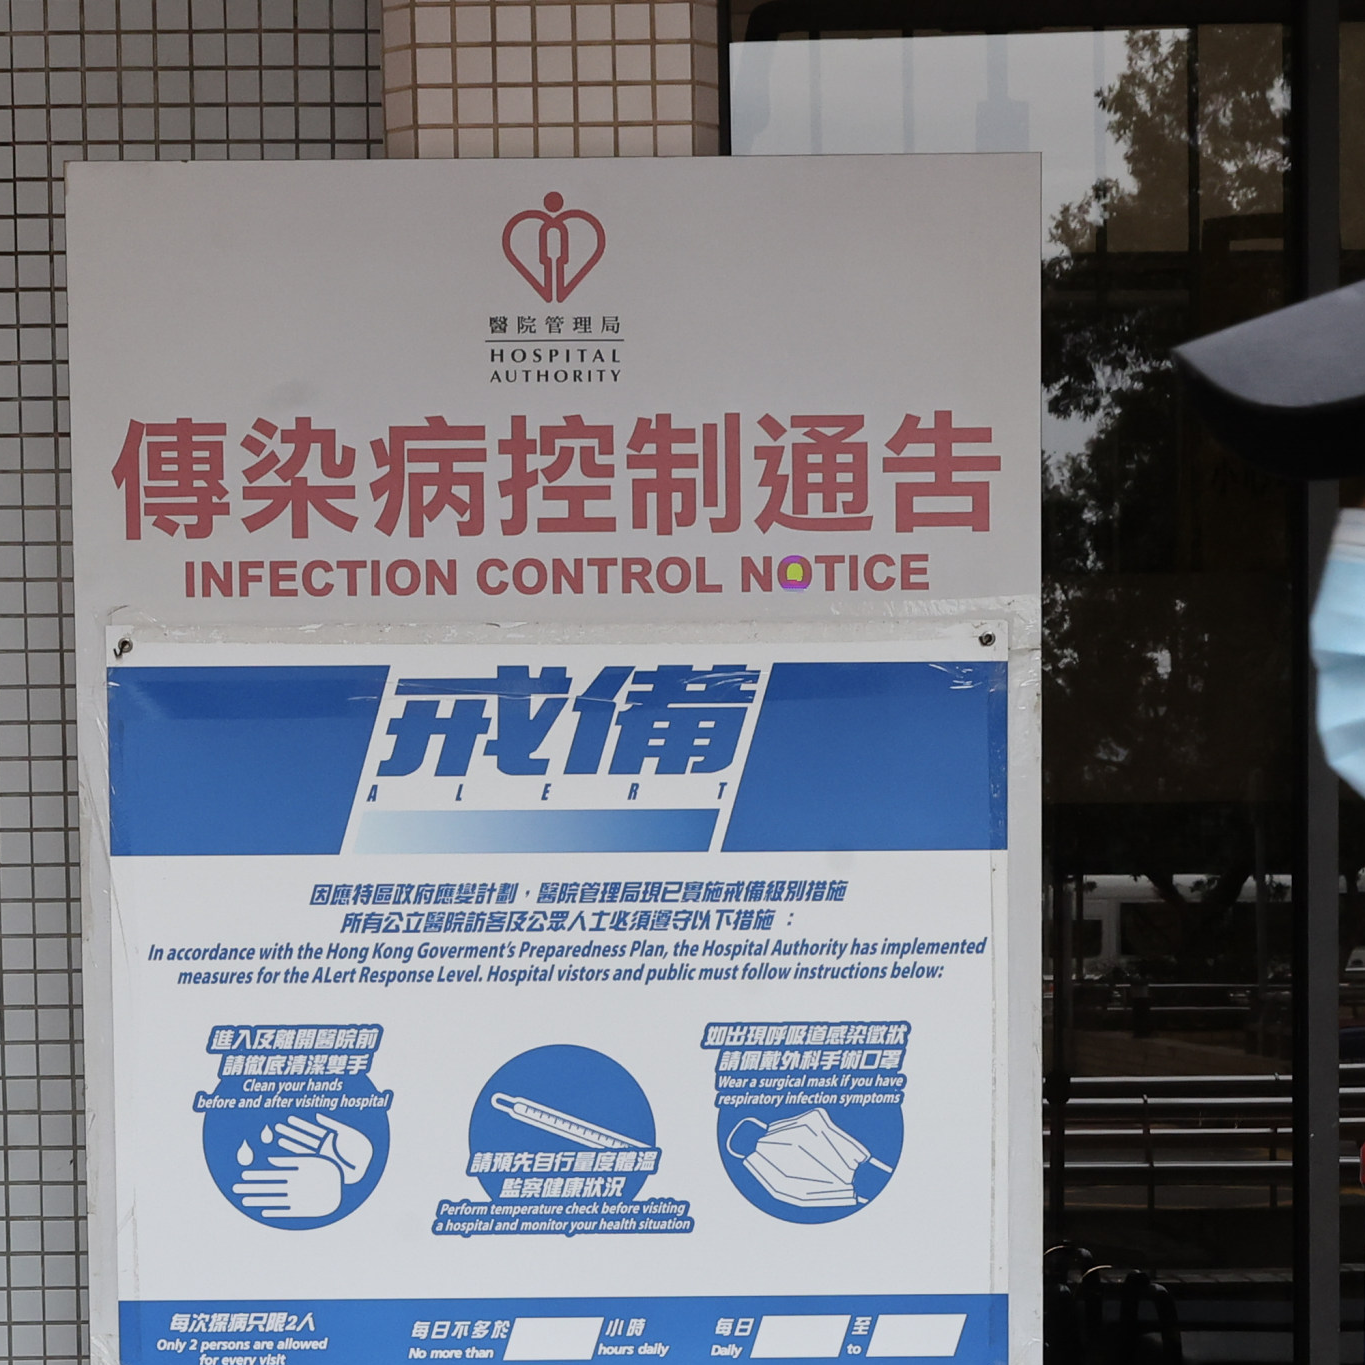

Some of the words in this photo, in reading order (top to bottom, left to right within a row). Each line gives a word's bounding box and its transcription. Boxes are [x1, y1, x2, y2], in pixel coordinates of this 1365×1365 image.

[490, 316, 619, 334] 醫院管理局
[490, 348, 620, 363] HOSPITAL
[491, 370, 620, 382] AUTHORITY
[113, 411, 1000, 540] 傳染病控制通告
[186, 560, 456, 597] INFECTION
[478, 557, 723, 595] CONTROL
[742, 554, 929, 592] NOTICE
[376, 664, 766, 778] 戒備
[148, 945, 164, 960] In
[167, 945, 256, 960] accordance
[258, 944, 294, 960] with
[297, 943, 324, 959] the
[326, 943, 369, 965] Hong
[373, 944, 414, 963] Kong
[519, 941, 627, 961] Preparedness
[630, 941, 669, 960] Plan,
[673, 941, 699, 957] the
[703, 939, 770, 960] Hospital
[772, 939, 848, 958] Authority
[851, 939, 878, 955] has
[881, 938, 987, 958] implemented
[179, 972, 253, 984] measures
[257, 967, 280, 984] for
[283, 967, 309, 983] the
[359, 967, 434, 986] Response
[438, 966, 483, 982] Level.
[487, 966, 555, 985] Hospital
[558, 968, 609, 981] vistors
[613, 965, 645, 981] and
[646, 964, 695, 984] public
[699, 966, 739, 980] must
[742, 964, 791, 979] follow
[794, 965, 887, 979] instructions
[891, 963, 944, 978] below:
[210, 1028, 379, 1050] 進入及離開醫院前
[705, 1025, 908, 1046] 如出現呼吸道感染徵狀
[222, 1054, 370, 1076] 請徹底清潔雙手
[718, 1050, 902, 1071] 請佩戴外科手術口罩
[243, 1079, 275, 1091] Clean
[277, 1082, 305, 1094] your
[307, 1079, 342, 1090] hands
[719, 1076, 748, 1087] Wear
[750, 1079, 756, 1087] a
[759, 1075, 806, 1090] surgical
[807, 1075, 838, 1086] mask
[841, 1075, 851, 1086] if
[850, 1078, 873, 1089] you
[875, 1074, 904, 1087] have
[198, 1095, 235, 1108] before
[238, 1095, 261, 1108] and
[264, 1095, 293, 1110] after
[296, 1095, 338, 1111] visiting
[340, 1094, 389, 1111] hospital
[718, 1093, 784, 1107] respiratory
[785, 1092, 838, 1104] infection
[840, 1092, 900, 1106] symptoms
[470, 1151, 658, 1173] 請預先自行量度體溫
[499, 1176, 626, 1198] 監察健康狀況
[441, 1203, 487, 1214] Perform
[491, 1205, 563, 1217] temperature
[566, 1203, 599, 1214] check
[602, 1203, 639, 1213] before
[643, 1203, 685, 1216] visiting
[436, 1223, 443, 1231] a
[446, 1219, 494, 1233] hospital
[495, 1219, 518, 1230] and
[521, 1219, 568, 1230] monitor
[569, 1222, 597, 1232] your
[599, 1219, 636, 1229] health
[639, 1220, 690, 1229] situation
[170, 1312, 315, 1332] 每次探病只限2人
[411, 1320, 510, 1340] 每日不多於
[605, 1318, 646, 1337] 小時
[715, 1318, 754, 1336] 每日
[851, 1316, 872, 1336] 至
[157, 1339, 187, 1353] Only
[189, 1339, 197, 1350] 2
[200, 1341, 250, 1352] persons
[253, 1341, 274, 1350] are
[277, 1338, 328, 1349] allowed
[409, 1348, 427, 1358] No
[430, 1350, 462, 1358] more
[465, 1347, 494, 1358] than
[597, 1343, 634, 1356] hours
[638, 1343, 669, 1357] daily
[711, 1344, 742, 1358] Daily
[847, 1344, 861, 1354] to
[200, 1354, 219, 1365] for
[260, 1354, 286, 1365] visit
